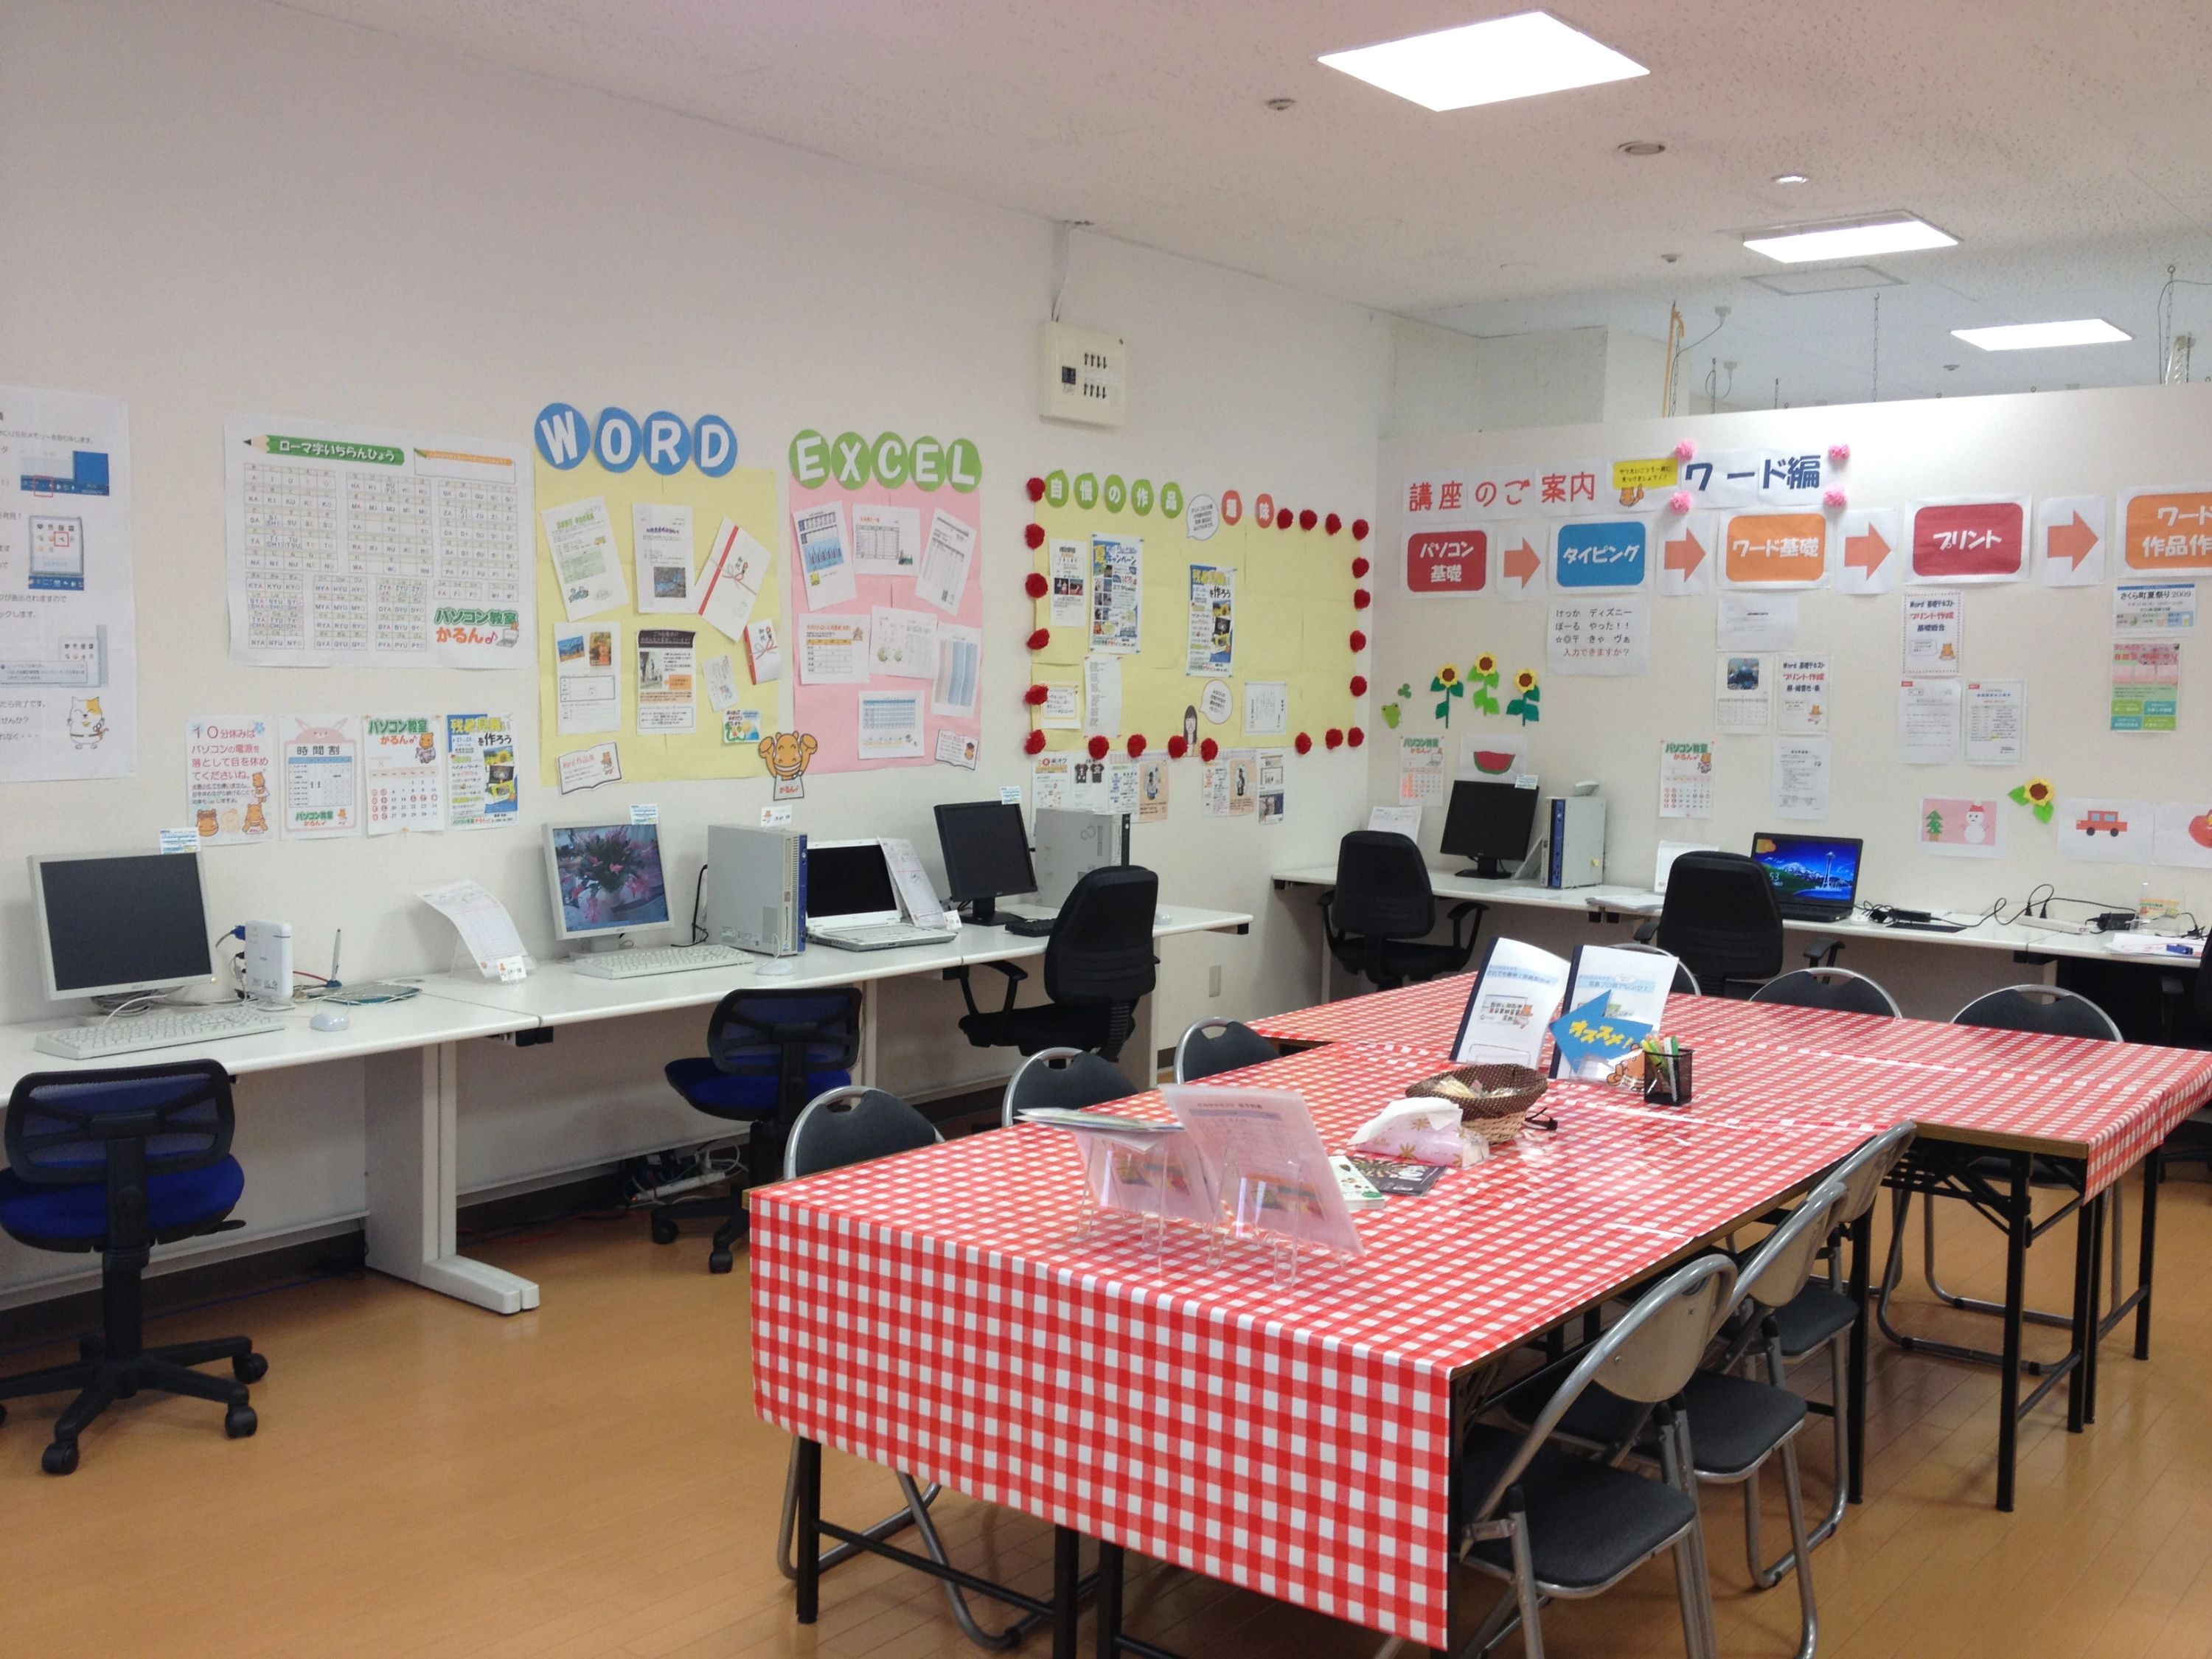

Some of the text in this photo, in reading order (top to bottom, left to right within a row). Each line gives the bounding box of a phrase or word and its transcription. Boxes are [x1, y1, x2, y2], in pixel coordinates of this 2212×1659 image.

[540, 411, 729, 467] WORD
[279, 440, 395, 462] ローマ字いちらんひょう
[796, 437, 975, 484] EXCEL
[1685, 455, 1821, 491] ワード編
[1409, 471, 1596, 512] 講座のご案内
[1733, 538, 1819, 558] ワード基礎
[1933, 529, 2003, 551] プリント
[1420, 541, 1475, 559] パソコン
[1563, 544, 1640, 564] タイピング
[1430, 564, 1462, 583] 基礎
[434, 608, 519, 627] パソコン教室
[1589, 608, 1632, 617] ディズニー
[1563, 647, 1630, 657] 入力できますか？
[369, 718, 428, 734] パソコン教室
[479, 733, 512, 746] を作ろう
[296, 745, 340, 755] 時間割
[192, 771, 250, 781] てくださいね。
[1569, 1020, 1634, 1050] オススメ！
